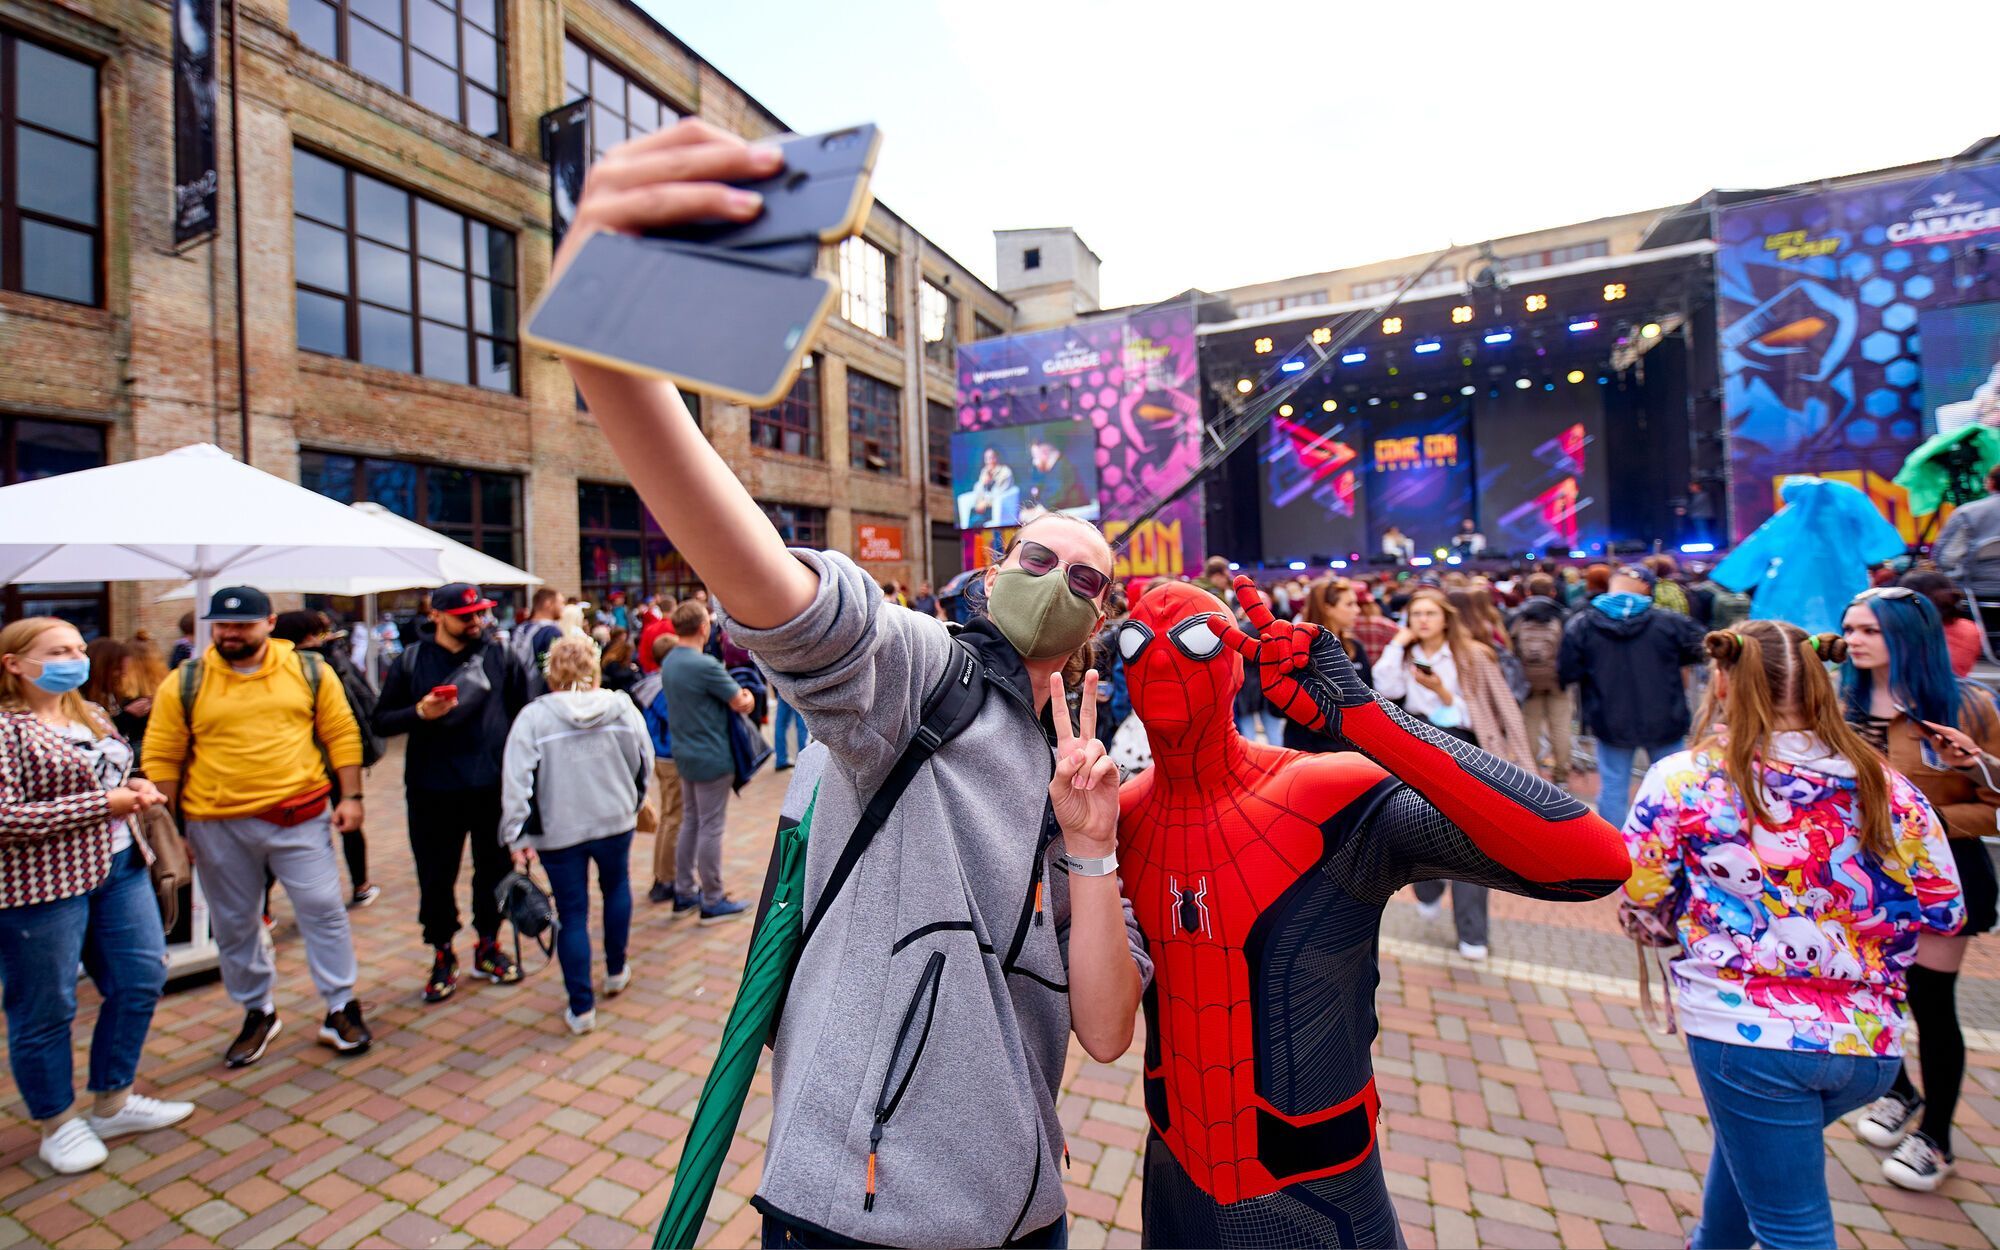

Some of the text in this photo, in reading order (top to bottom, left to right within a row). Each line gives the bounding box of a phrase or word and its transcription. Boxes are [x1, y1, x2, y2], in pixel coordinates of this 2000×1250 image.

[1886, 207, 2000, 243] GARAGE
[1765, 230, 1808, 249] LET'S
[1041, 351, 1100, 374] GARAGE
